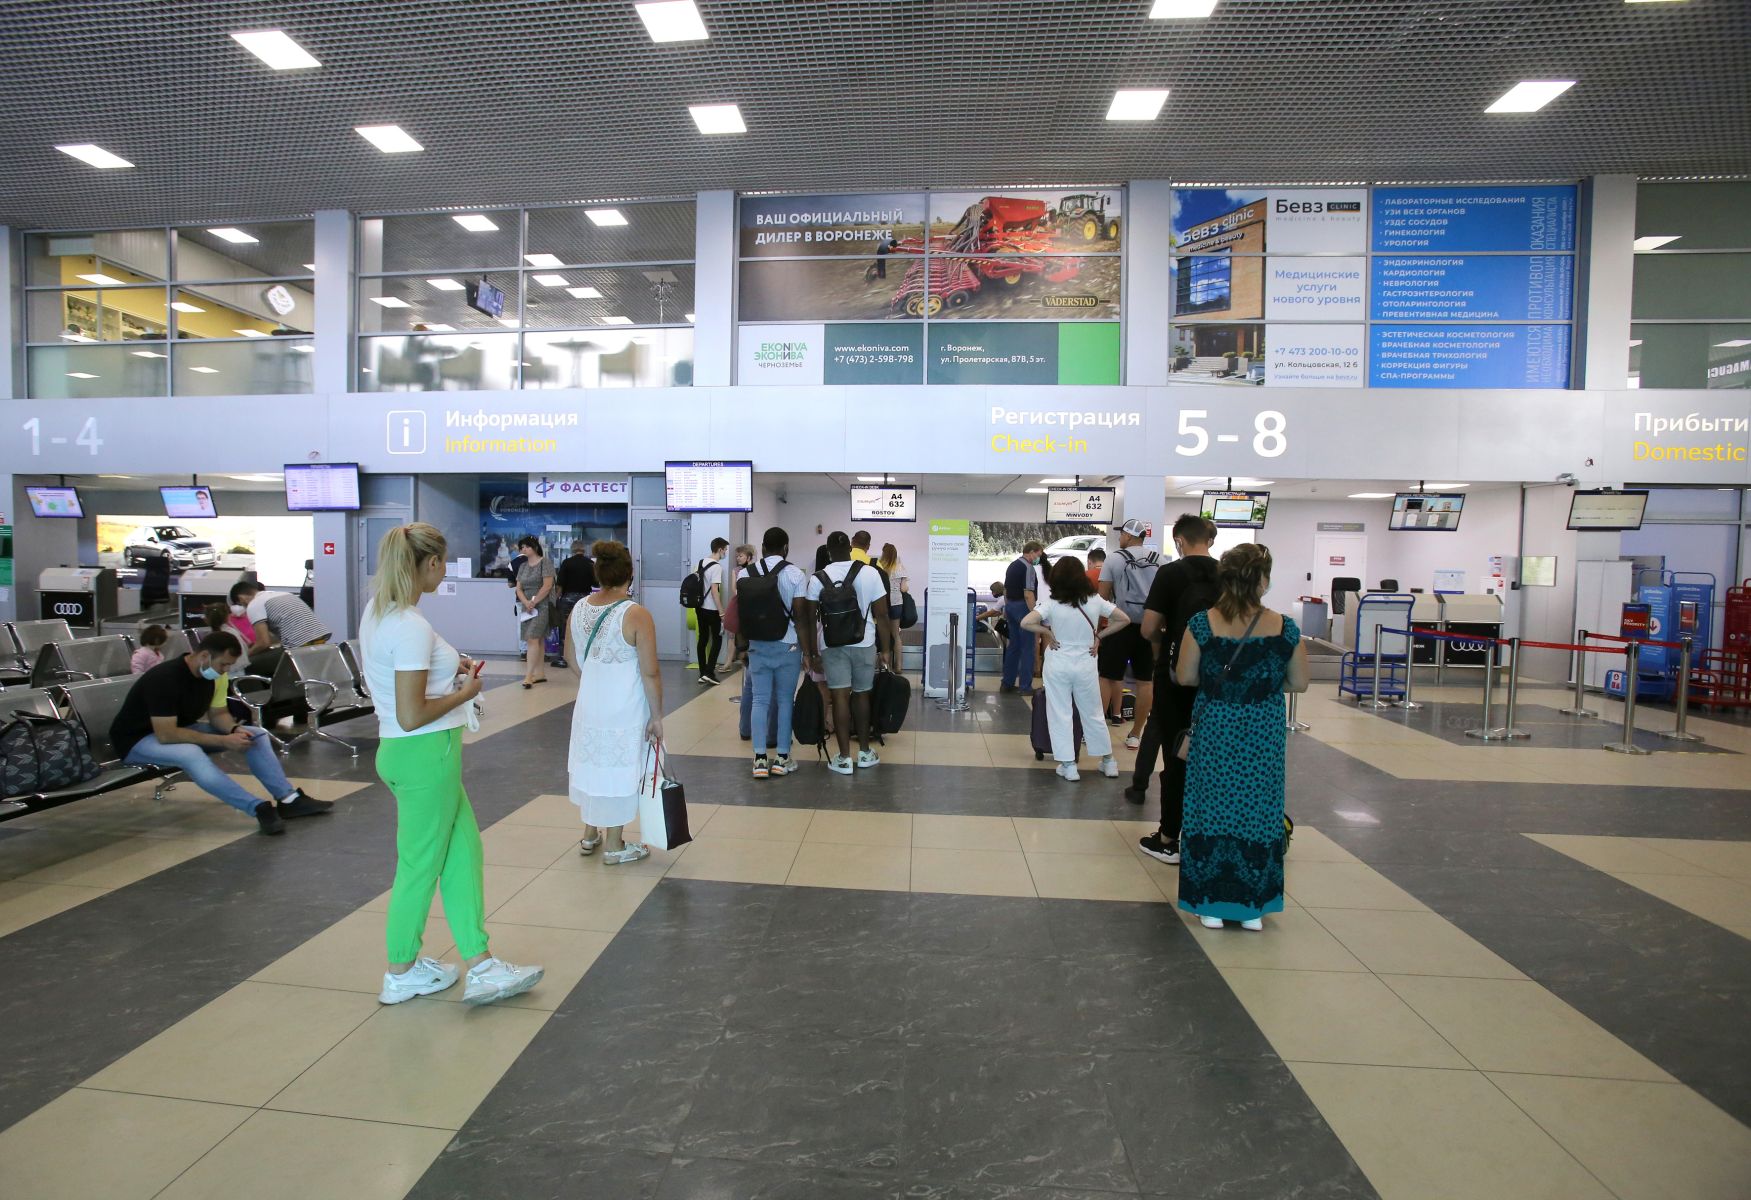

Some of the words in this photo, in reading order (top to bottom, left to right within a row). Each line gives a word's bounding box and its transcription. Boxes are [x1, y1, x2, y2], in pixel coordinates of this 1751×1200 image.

[1276, 199, 1323, 213] Бевз
[756, 214, 786, 224] ВАШ
[790, 208, 903, 224] ОФИЦИАЛЬНЫЙ
[1222, 208, 1254, 226] clinic
[755, 232, 801, 244] ДИЛЕР
[804, 232, 812, 242] В
[816, 230, 893, 242] ВОРОНЕЖЕ
[1275, 270, 1360, 280] Медицинские
[1296, 284, 1337, 293] услуги
[1045, 296, 1096, 306] VÄDERSTAD
[1317, 296, 1360, 306] уровня
[761, 342, 808, 350] EKONIVA
[947, 345, 985, 353] Воронеж,
[754, 352, 804, 360] ЭКОНИВА
[846, 355, 868, 364] (473)
[869, 355, 914, 363] 2-598-798
[953, 356, 1010, 364] Пролетарская,
[1526, 325, 1542, 383] ИМЕЮТСЯ
[446, 408, 578, 432] Информация
[991, 406, 1141, 428] Регистрация
[1634, 412, 1748, 437] Прибыти
[991, 434, 1088, 454] Check-in
[1633, 441, 1746, 461] Domestic
[560, 482, 628, 493] ФАСТЕСТ
